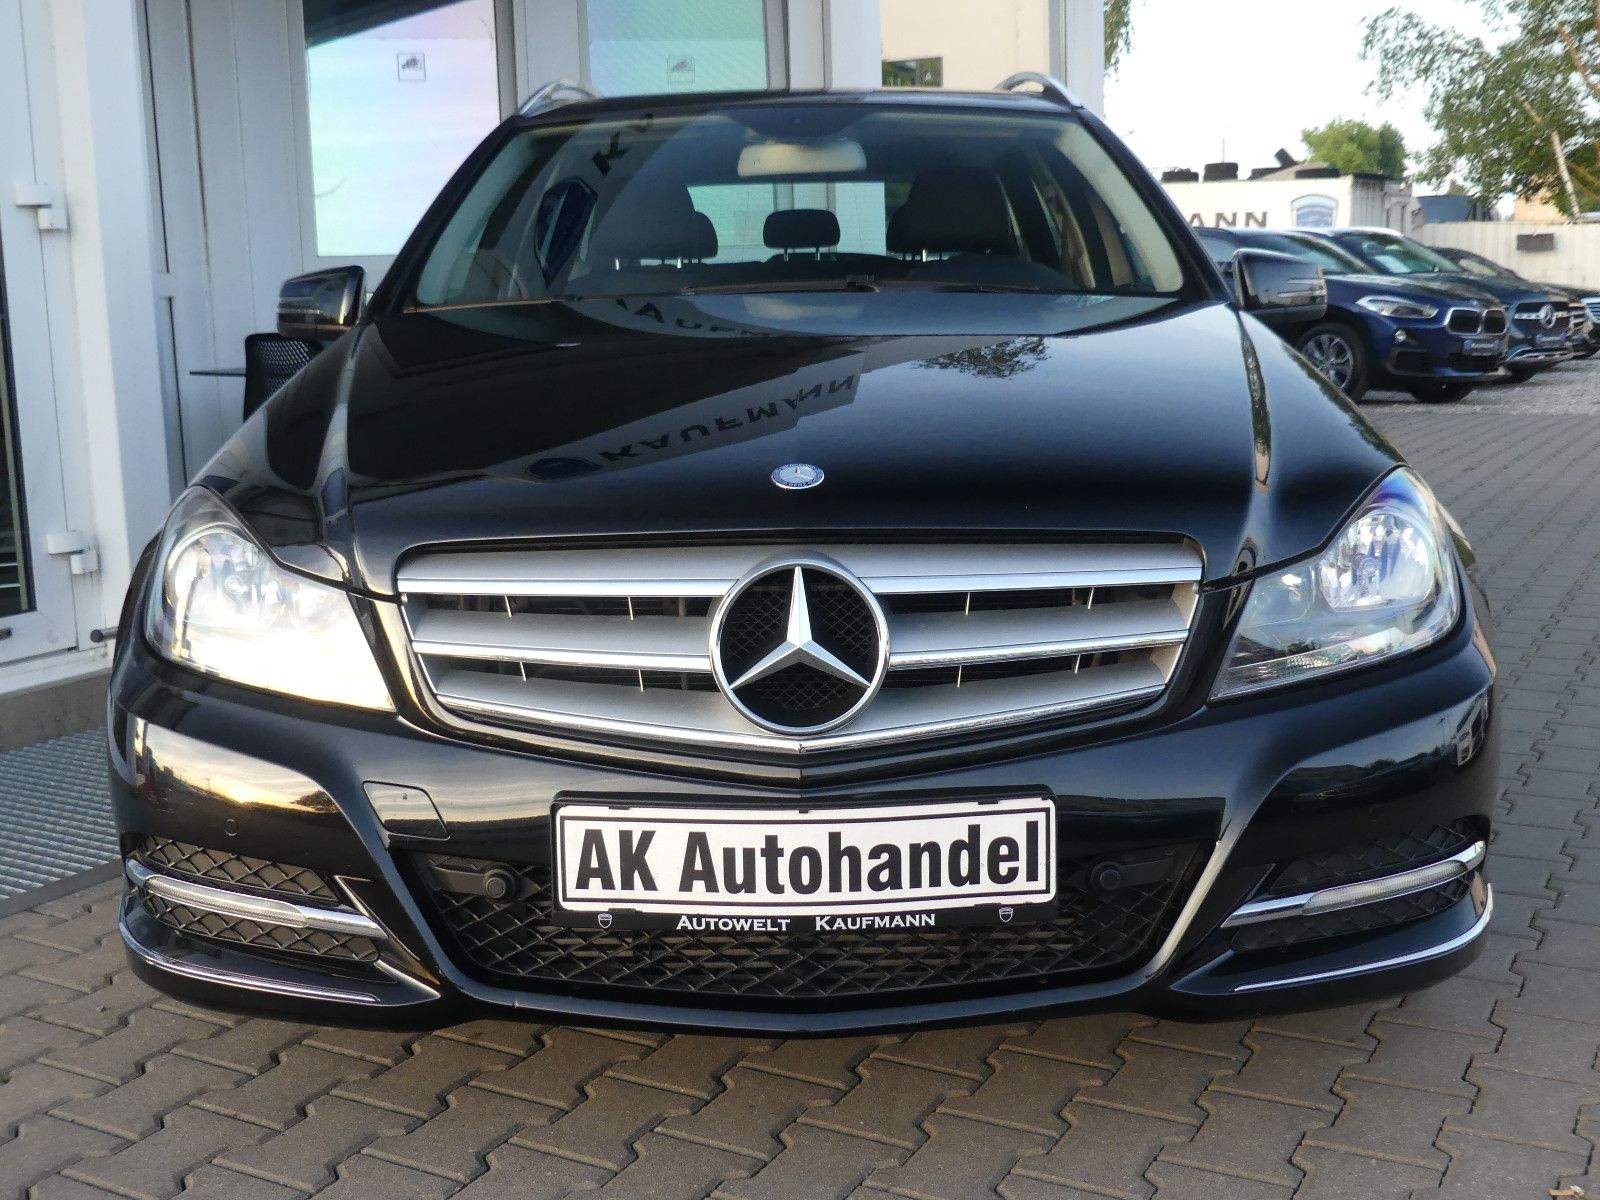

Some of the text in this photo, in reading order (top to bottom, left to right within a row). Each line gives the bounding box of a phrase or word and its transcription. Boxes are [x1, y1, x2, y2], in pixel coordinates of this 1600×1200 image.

[575, 820, 1039, 895] AK Autohandel
[676, 913, 936, 932] AUTOWELT KAUFMANN
